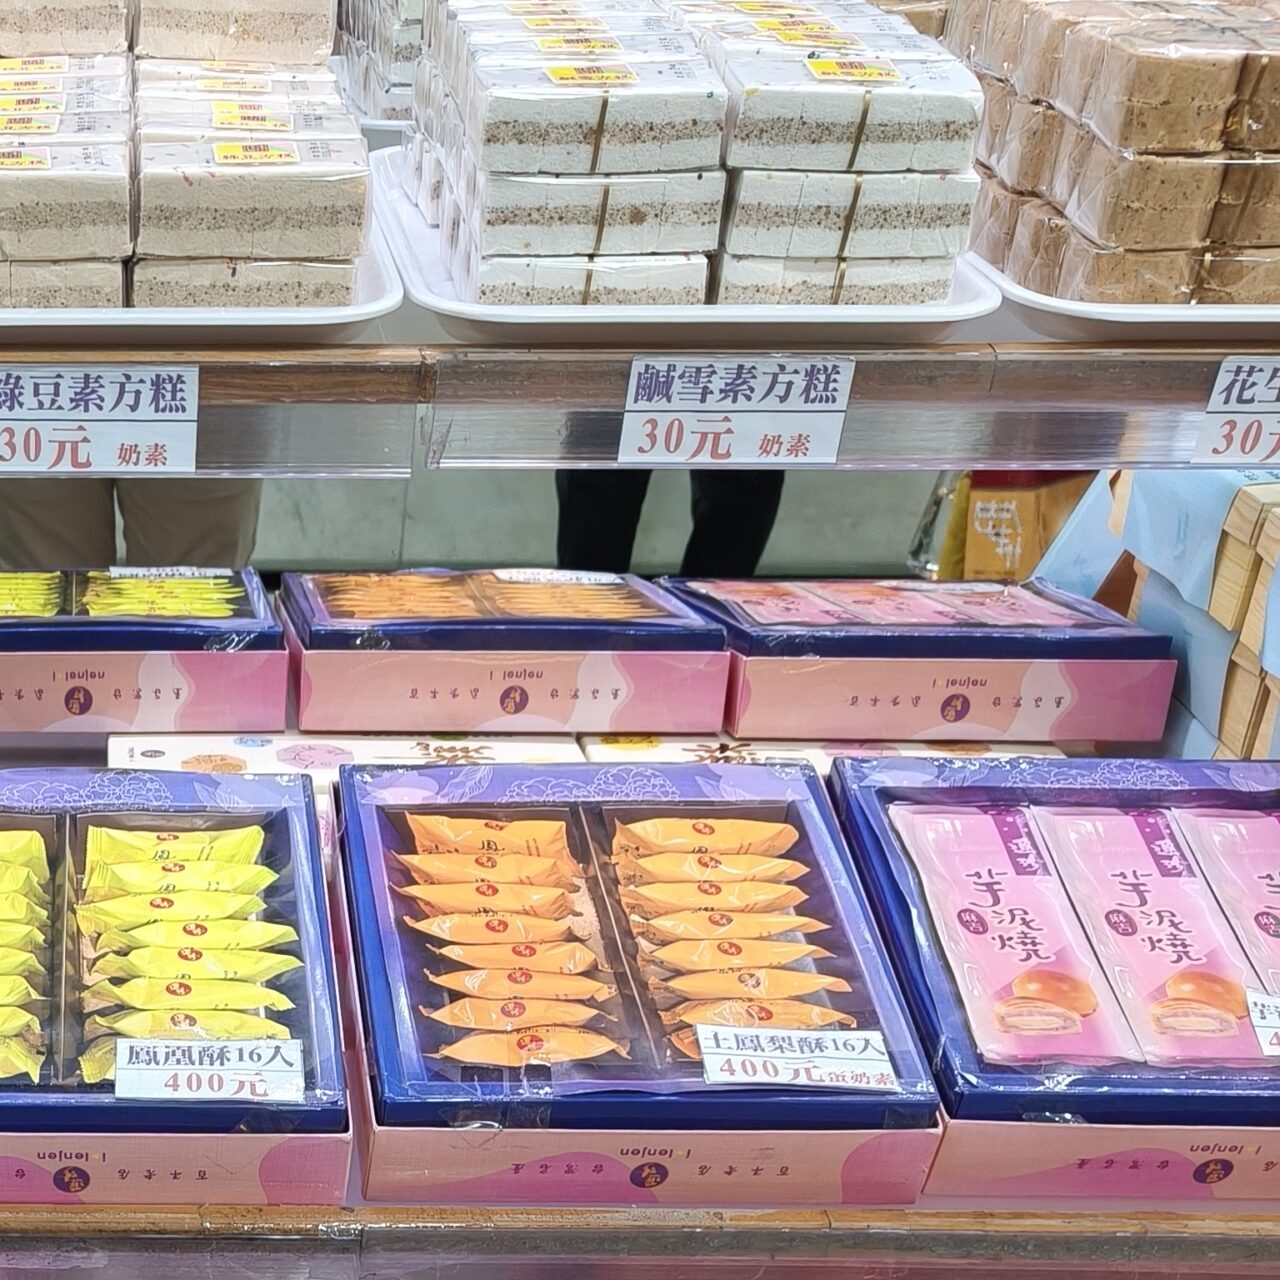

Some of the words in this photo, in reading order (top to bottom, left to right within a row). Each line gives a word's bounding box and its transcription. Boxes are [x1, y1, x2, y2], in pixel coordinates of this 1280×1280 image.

[632, 363, 842, 405] 鹹雪素方糕
[636, 415, 735, 462] 30元
[757, 433, 812, 459] 奶素
[116, 442, 168, 467] 奶素
[965, 868, 1051, 963] 芋泥燒
[1110, 868, 1203, 964] 芋泥燒
[126, 1044, 295, 1068] 鳳凰酥16入
[703, 1031, 887, 1057] 土鳳梨酥16入
[719, 1057, 826, 1083] 400元
[164, 1072, 269, 1097] 400元
